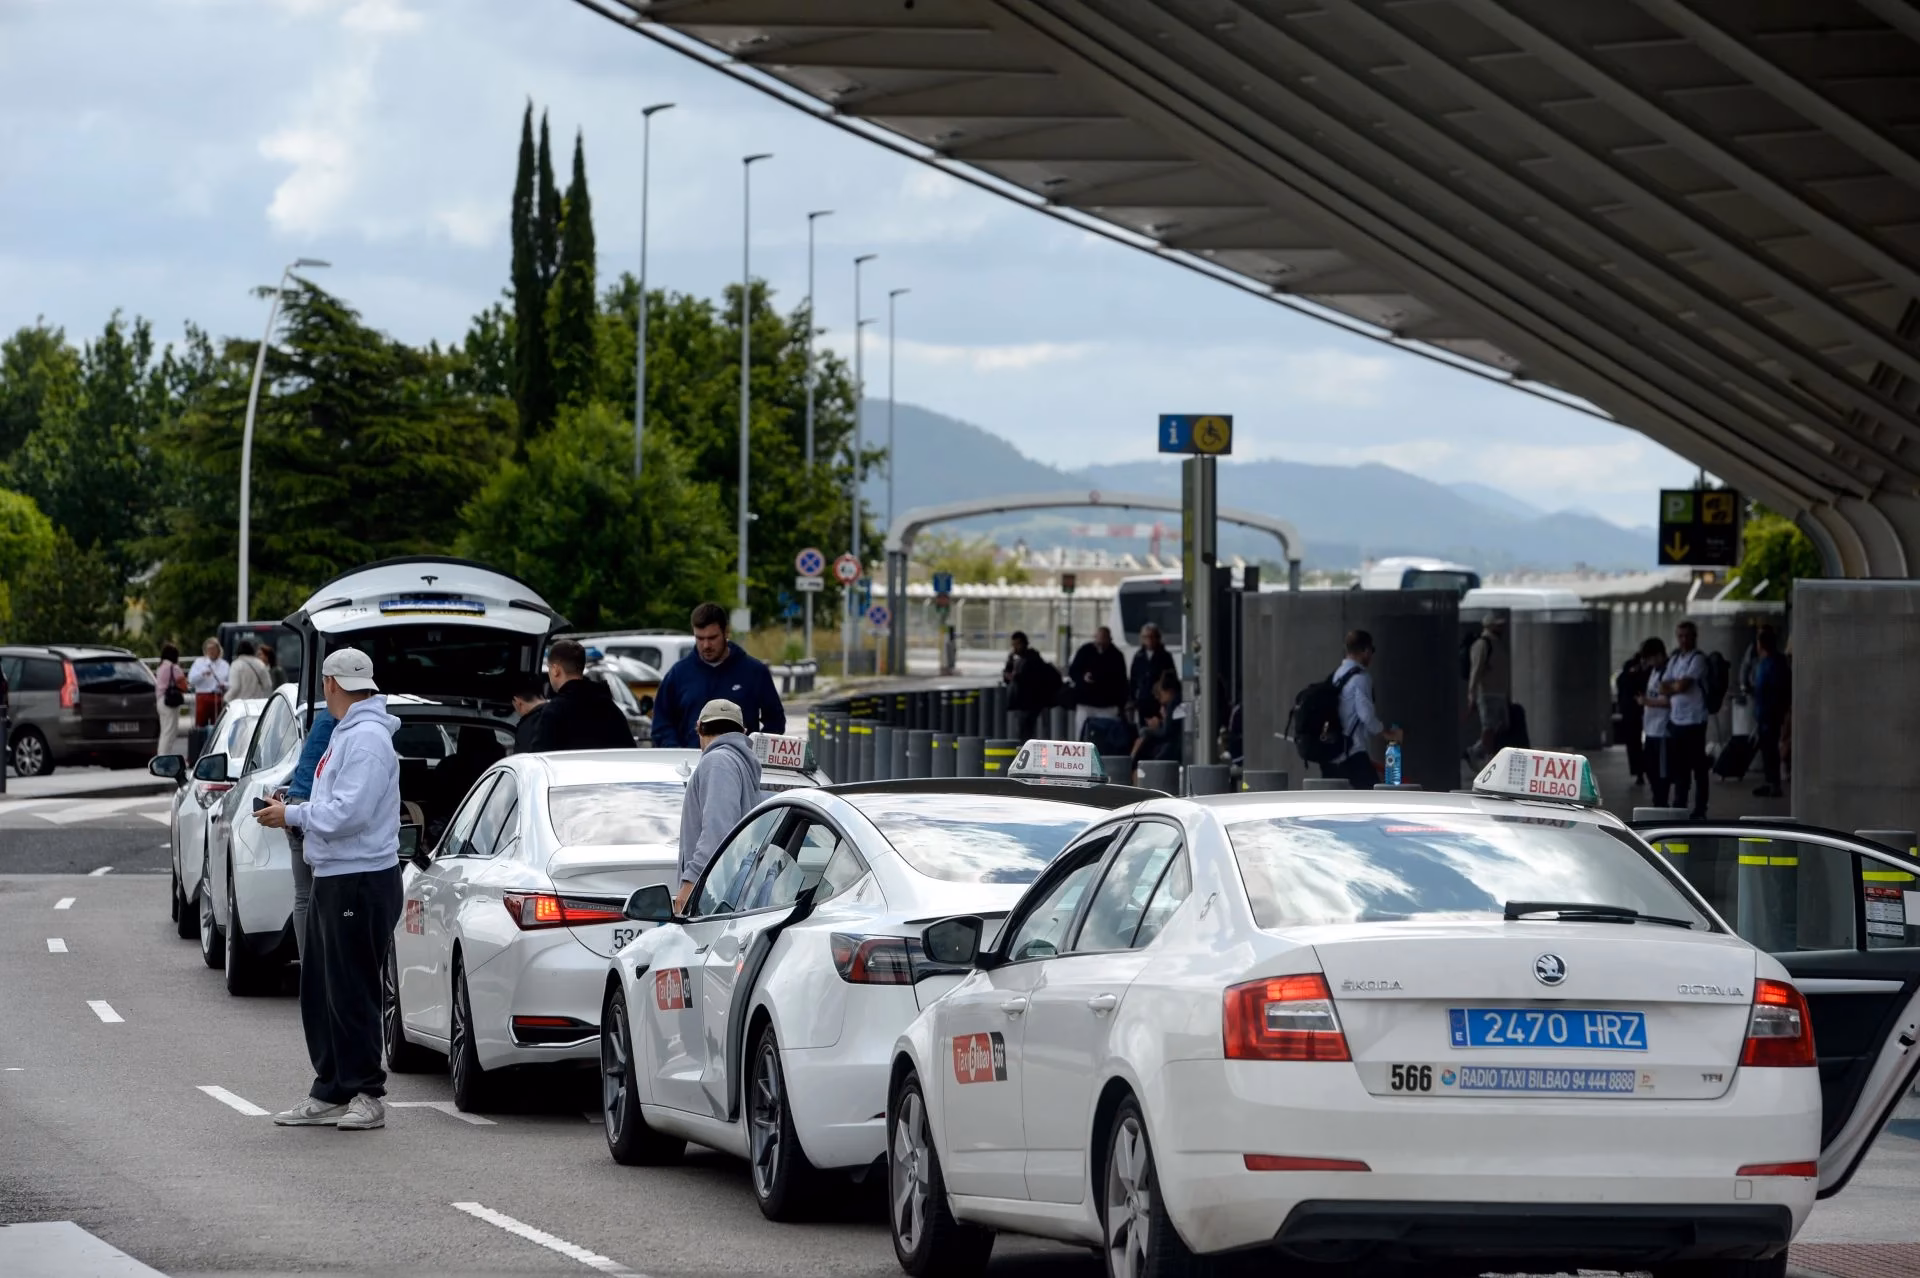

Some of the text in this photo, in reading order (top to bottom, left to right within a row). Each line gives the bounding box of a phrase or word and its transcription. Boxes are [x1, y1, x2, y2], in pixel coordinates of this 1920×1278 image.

[770, 738, 802, 756] TAXI
[1053, 744, 1086, 757] TAXI
[767, 754, 801, 767] BILBAO
[1015, 749, 1031, 770] 9
[1054, 761, 1084, 771] BILBAO
[1532, 755, 1577, 781] TAXI
[1529, 779, 1577, 798] BILBAO
[1678, 984, 1744, 997] OCTAVIA
[1455, 1031, 1464, 1041] E
[1483, 1012, 1643, 1046] 2470 HRZ
[1391, 1063, 1433, 1092] 566
[1460, 1068, 1634, 1090] RADIO TAXI BILBAO 94 444 8888
